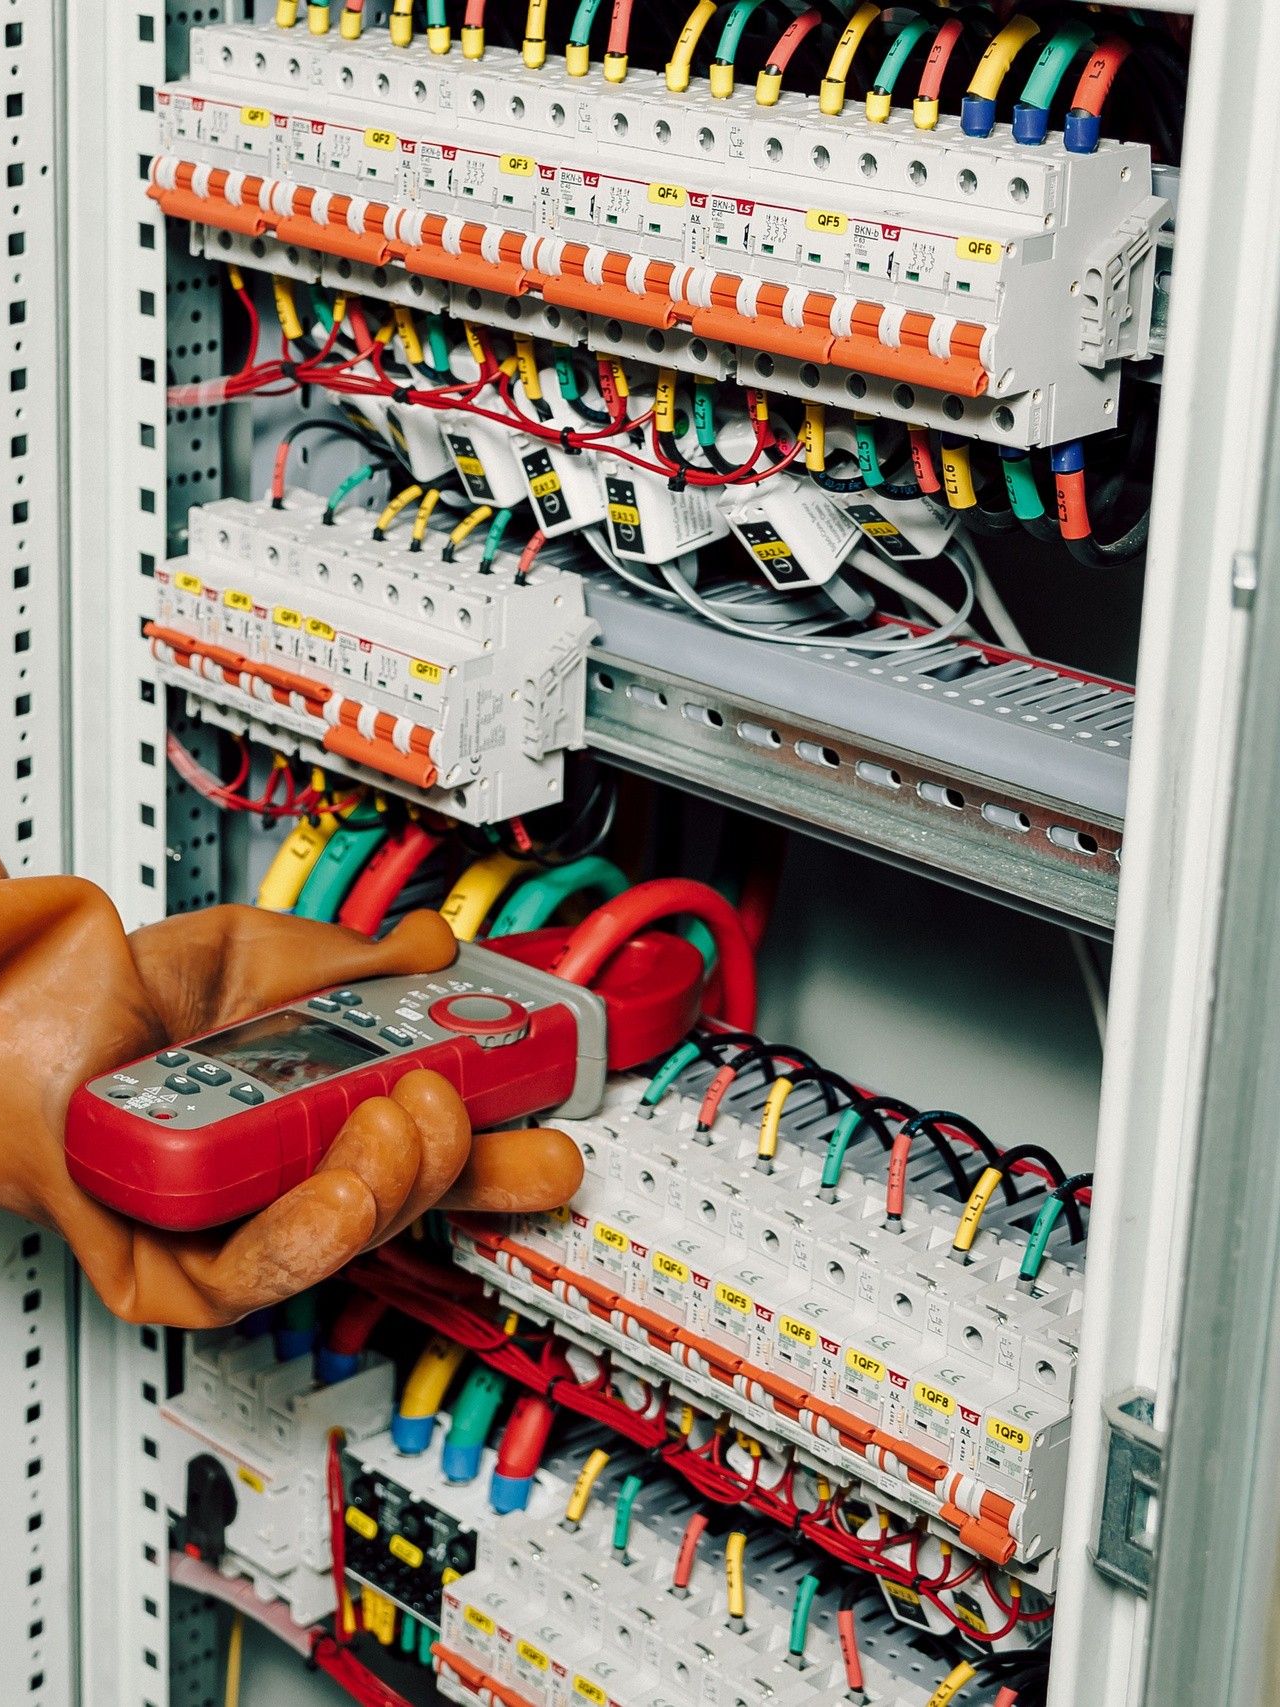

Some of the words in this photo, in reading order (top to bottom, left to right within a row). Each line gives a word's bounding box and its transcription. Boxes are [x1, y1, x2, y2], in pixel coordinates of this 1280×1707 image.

[726, 10, 741, 27] L2
[680, 28, 693, 44] L1
[784, 23, 798, 38] L3
[841, 29, 855, 46] L1
[889, 38, 902, 57] L2
[929, 45, 942, 63] L3
[984, 42, 998, 59] L1
[1039, 46, 1055, 66] L2
[1089, 59, 1106, 79] L3
[248, 110, 265, 121] QF1
[312, 124, 324, 134] LS
[372, 133, 390, 145] QF2
[402, 142, 414, 152] LS
[443, 150, 455, 160] LS
[509, 158, 528, 170] QF3
[541, 169, 553, 178] LS
[561, 172, 582, 183] BKN-b
[585, 176, 598, 186] LS
[658, 187, 678, 200] QF4
[691, 196, 704, 206] LS
[712, 199, 735, 211] BKN-b
[739, 203, 752, 214] LS
[818, 214, 840, 227] QF5
[854, 225, 880, 238] BKN-b
[884, 228, 898, 239] LS
[968, 241, 992, 255] QF6
[557, 357, 569, 386] L2.3
[601, 375, 613, 404] L3.3
[656, 384, 669, 415] L1.4
[695, 399, 706, 429] L2.4
[858, 441, 873, 472] L2.5
[943, 464, 958, 495] L1.6
[1005, 474, 1017, 505] L2.6
[1057, 490, 1068, 523] L3.6
[757, 546, 785, 558] EA2.4
[416, 663, 439, 678] QF11
[291, 834, 317, 860] L1
[328, 835, 351, 863] L2
[113, 1074, 139, 1085] COM
[827, 1129, 841, 1158] 1.L2
[892, 1158, 903, 1189] 1.L3
[964, 1194, 983, 1223] 1.L1
[574, 1215, 588, 1228] LS
[600, 1228, 623, 1246] 1QF3
[1030, 1217, 1044, 1249] 1.L2
[632, 1243, 646, 1257] LS
[658, 1257, 683, 1276] 1QF4
[695, 1276, 709, 1289] LS
[721, 1289, 747, 1308] 1QF5
[758, 1308, 772, 1322] LS
[804, 1302, 828, 1316] CE
[785, 1321, 811, 1341] 1QF6
[823, 1341, 837, 1355] LS
[871, 1335, 896, 1349] CE
[852, 1354, 880, 1373] 1QF7
[891, 1374, 906, 1389] LS
[940, 1369, 965, 1383] CE
[921, 1388, 949, 1408] 1QF8
[963, 1411, 978, 1426] LS
[1013, 1404, 1039, 1419] CE
[960, 1426, 970, 1437] AX
[995, 1424, 1024, 1444] 1QF9
[985, 1438, 1006, 1452] BKN-b
[928, 1683, 952, 1707] 2.L1
